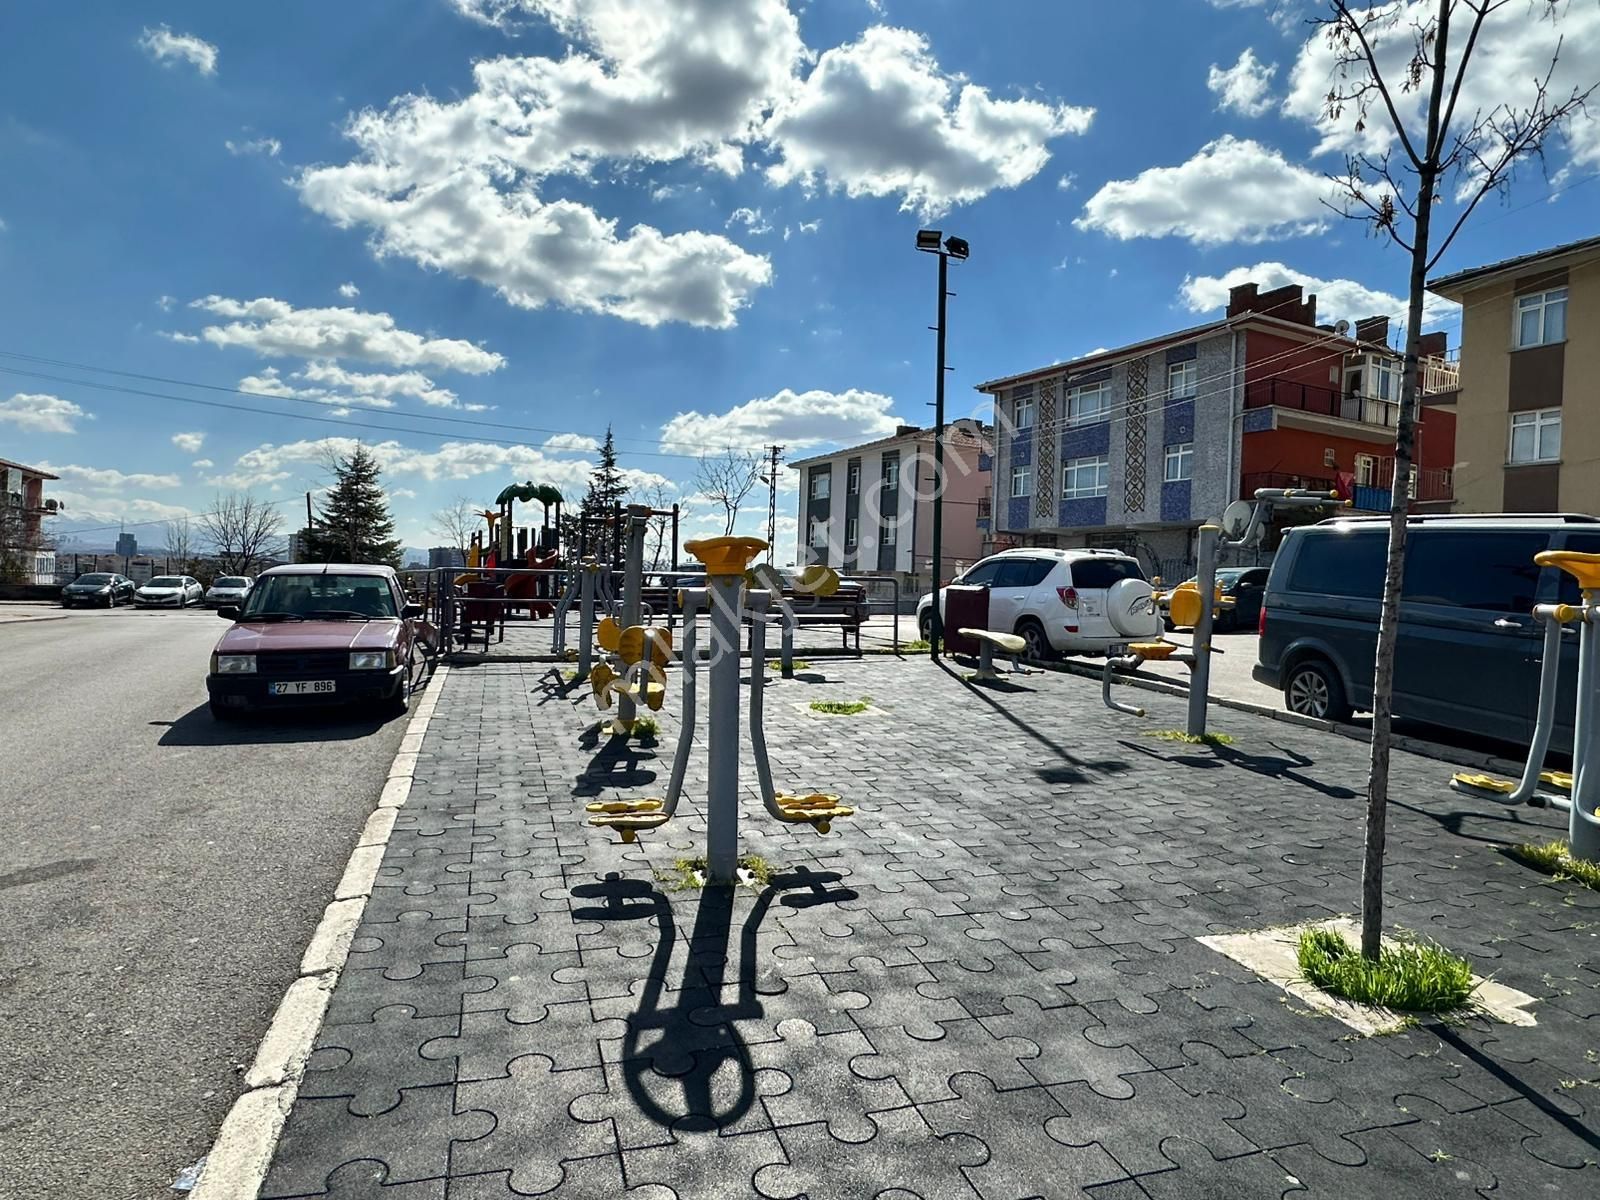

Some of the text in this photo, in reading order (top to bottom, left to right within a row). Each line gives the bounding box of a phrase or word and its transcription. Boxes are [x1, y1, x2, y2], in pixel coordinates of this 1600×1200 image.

[275, 681, 333, 693] 27 YF 896
